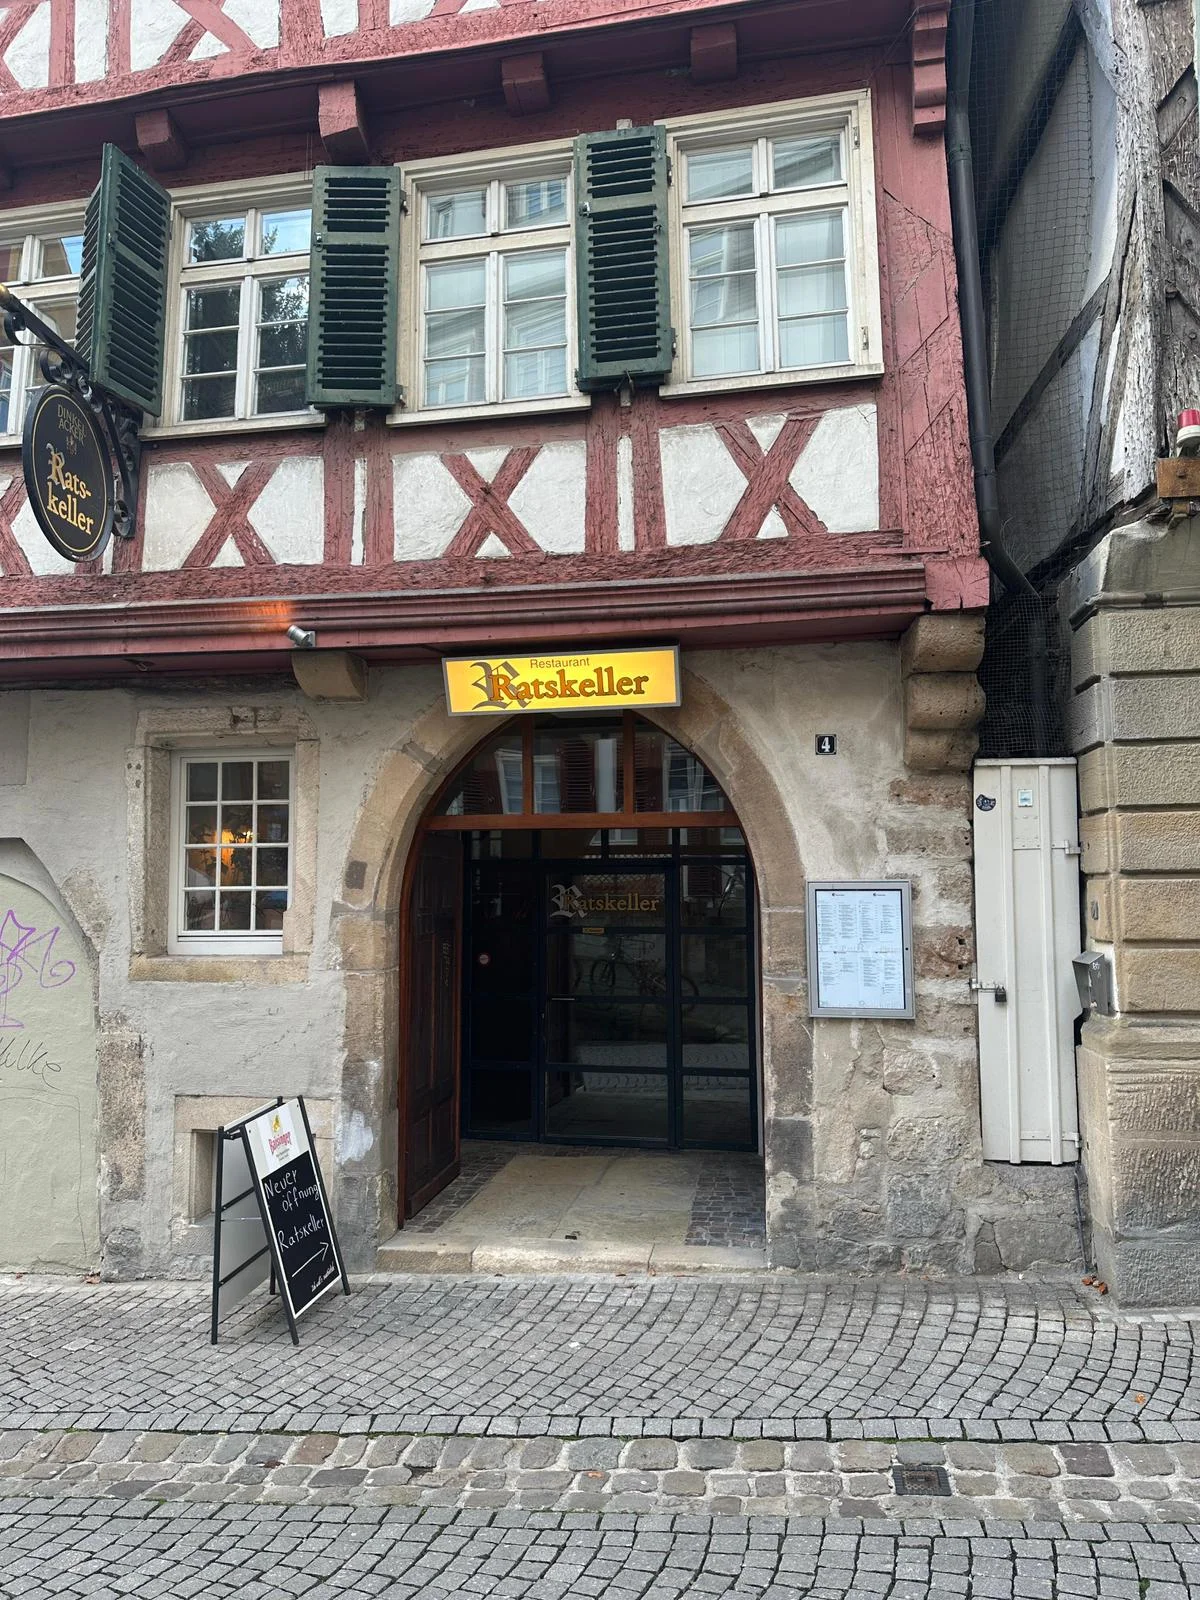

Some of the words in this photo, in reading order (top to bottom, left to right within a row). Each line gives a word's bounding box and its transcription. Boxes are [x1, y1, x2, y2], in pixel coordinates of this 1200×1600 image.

[58, 417, 85, 447] ACKER
[45, 443, 92, 499] Rats-
[47, 481, 94, 535] keller
[530, 657, 590, 669] Restaurant
[471, 661, 649, 710] Ratskeller
[821, 736, 831, 753] 4
[552, 885, 659, 915] Ratskeller
[264, 1169, 297, 1199] Neuer
[277, 1213, 325, 1253] Ratskeller
